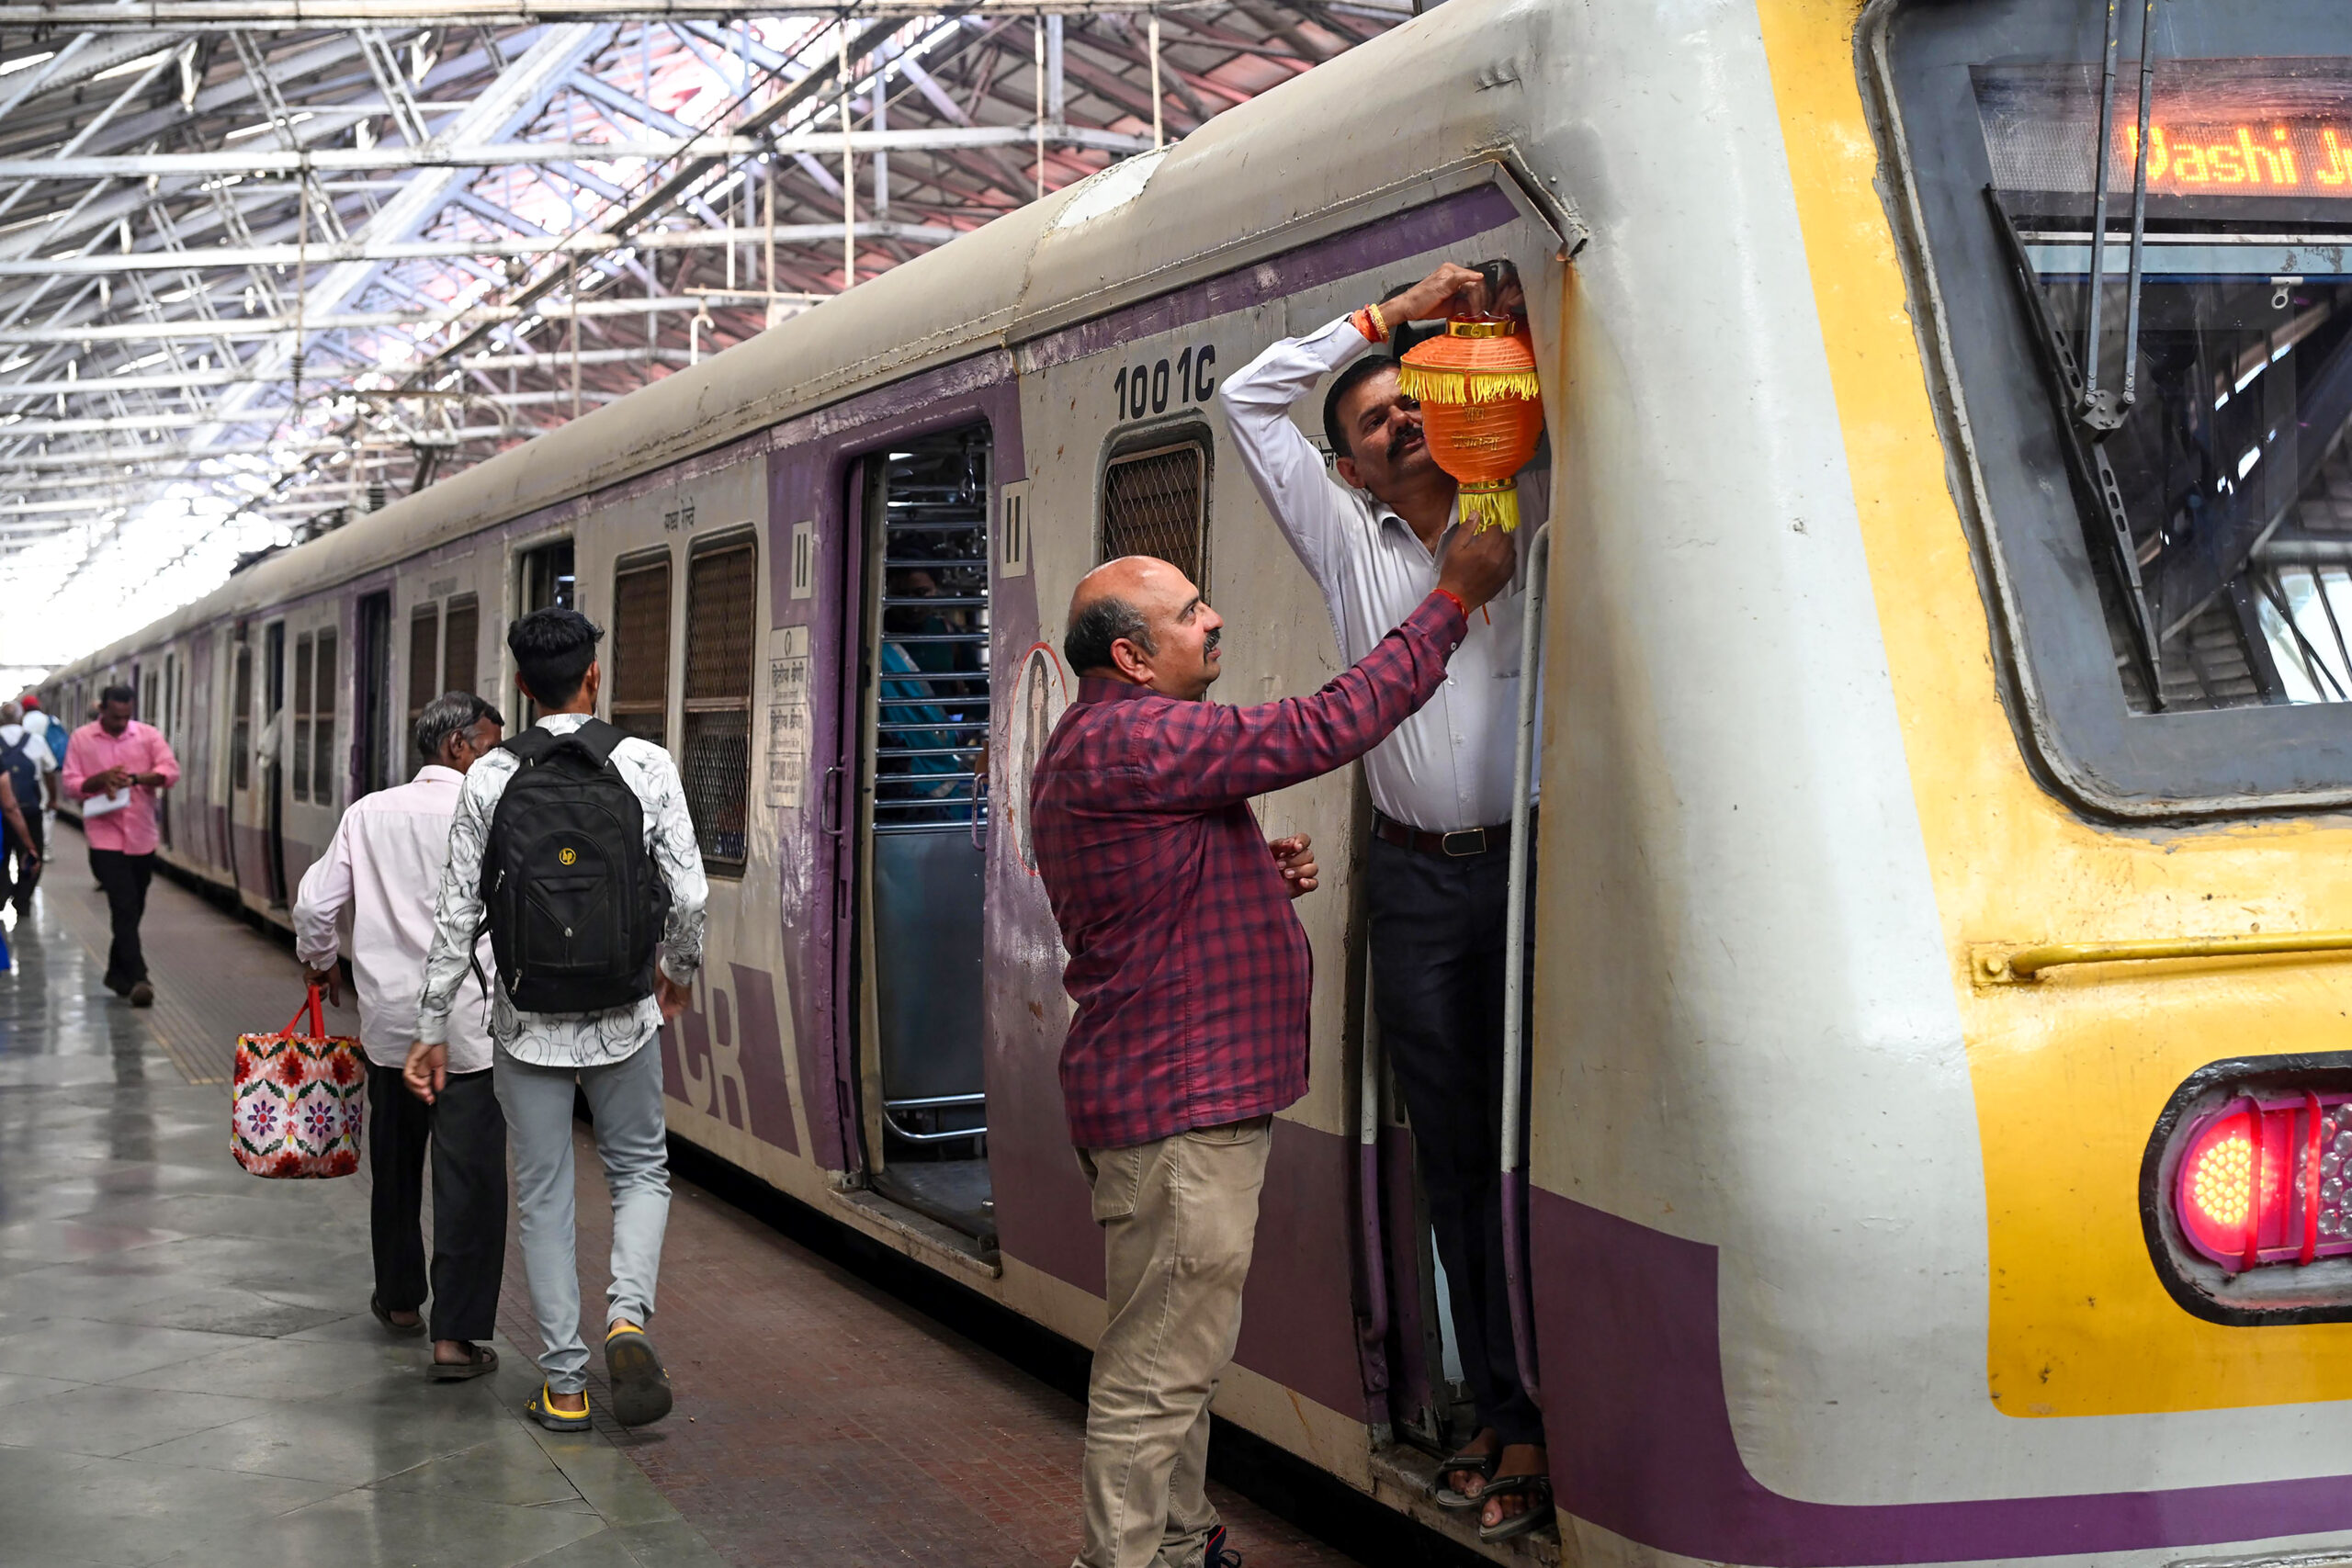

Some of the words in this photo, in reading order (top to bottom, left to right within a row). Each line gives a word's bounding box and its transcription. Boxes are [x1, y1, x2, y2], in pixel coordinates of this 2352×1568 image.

[2126, 124, 2299, 185] Vashi
[1114, 344, 1216, 421] 1001C
[673, 961, 753, 1135] CR
